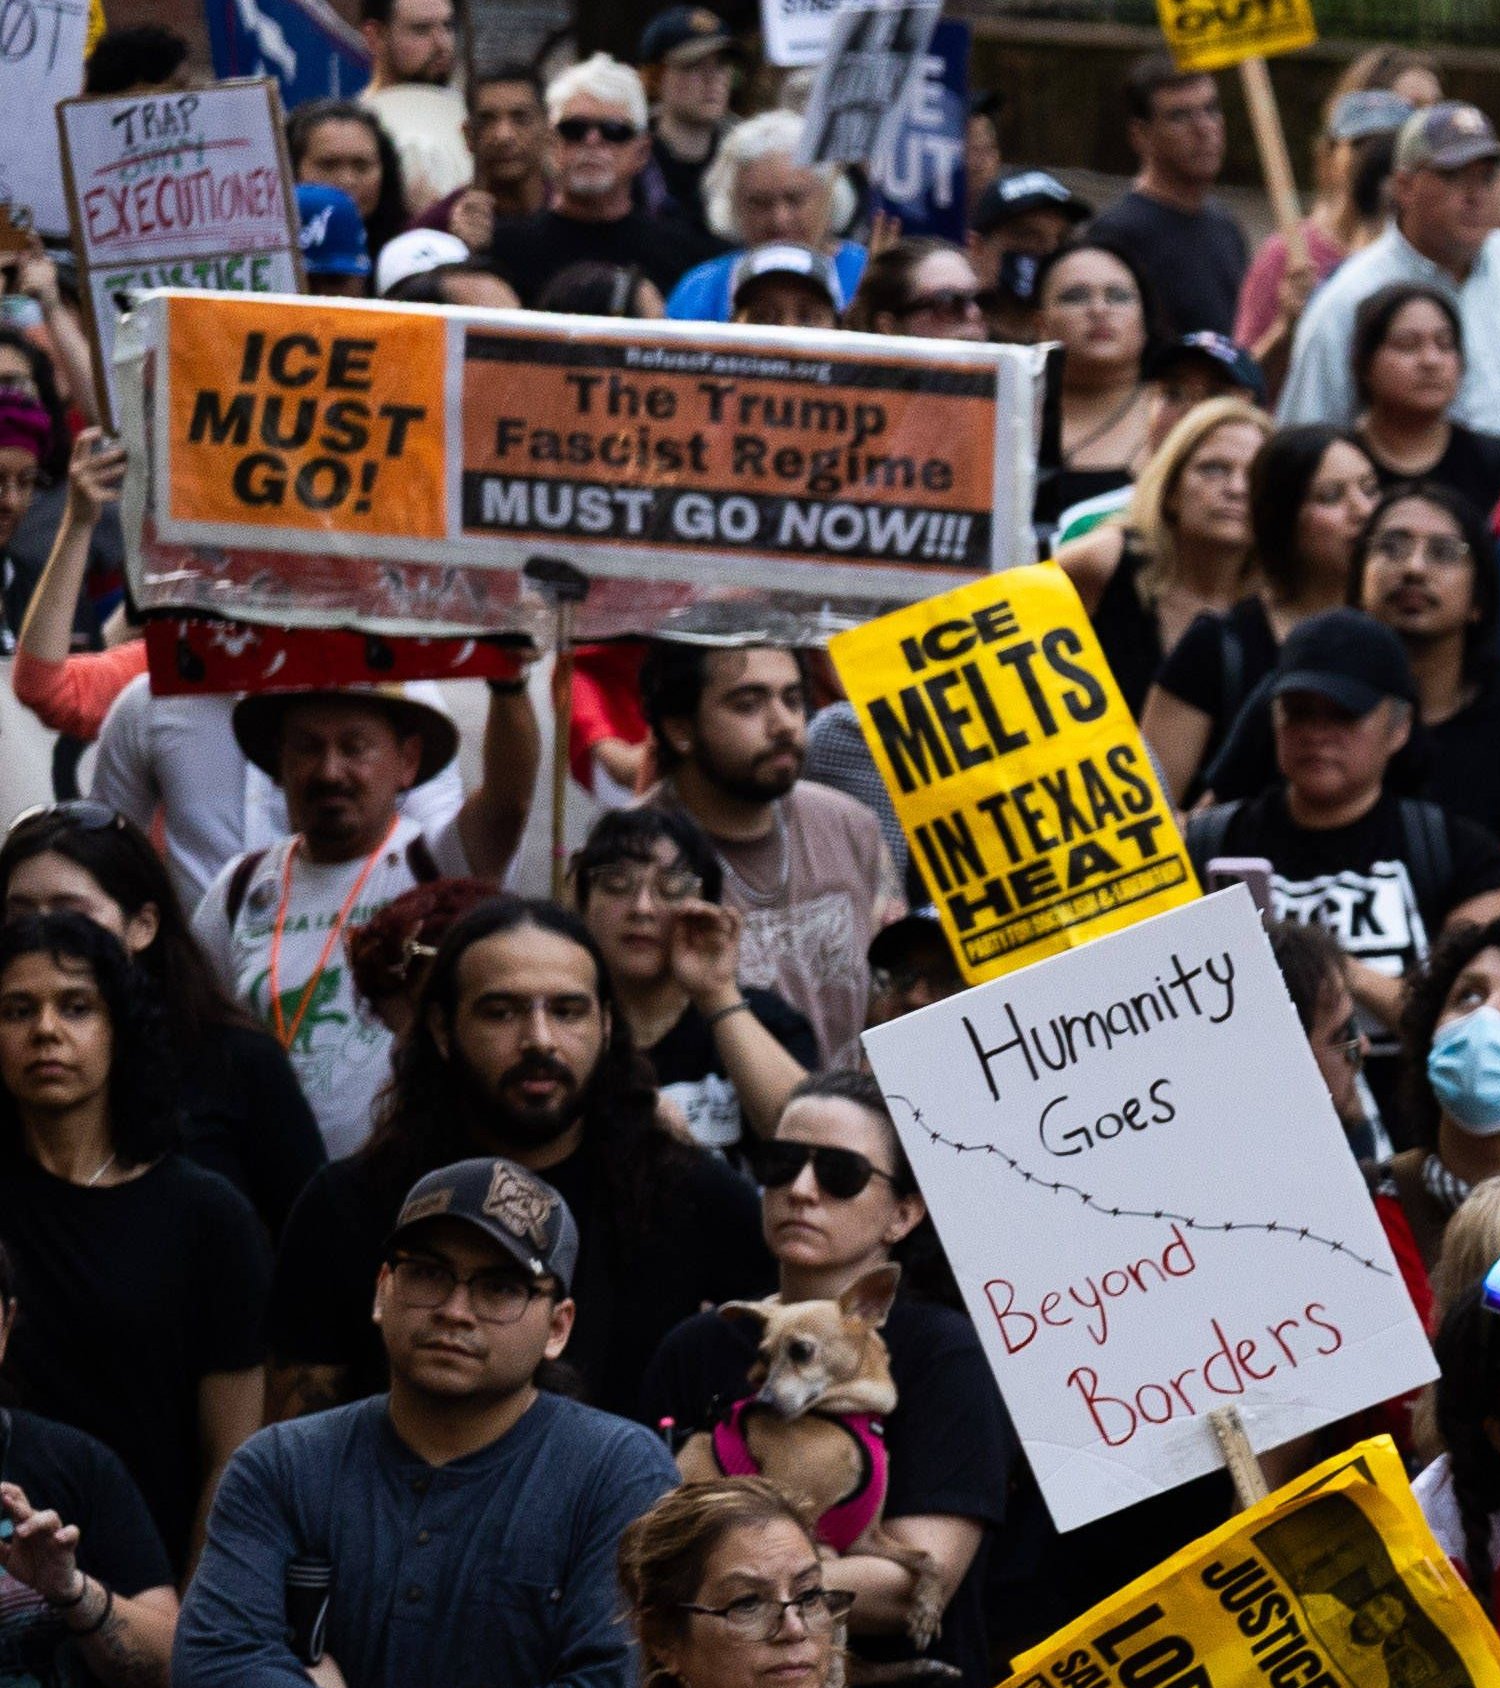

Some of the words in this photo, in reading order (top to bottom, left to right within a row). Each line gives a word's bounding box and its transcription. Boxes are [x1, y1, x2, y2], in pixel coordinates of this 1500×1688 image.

[112, 96, 200, 147] TRAP
[239, 331, 379, 393] ICE
[188, 388, 428, 459] MUST
[566, 372, 678, 420] The
[699, 382, 889, 448] Trump
[231, 452, 381, 514] GO!
[495, 418, 710, 474] Fascist
[731, 433, 955, 496] Regime
[480, 478, 656, 535] MUST
[672, 492, 762, 543] GO
[777, 498, 974, 560] NOW!!!
[900, 600, 1021, 673] ICE
[866, 626, 1109, 795] MELTS
[913, 808, 988, 894] IN
[976, 743, 1154, 863] TEXAS
[945, 815, 1164, 932] HEAT
[962, 951, 1236, 1102] Humanity
[1038, 1077, 1177, 1158] Goes
[983, 1223, 1196, 1354] Beyond
[1066, 1302, 1344, 1447] Borders
